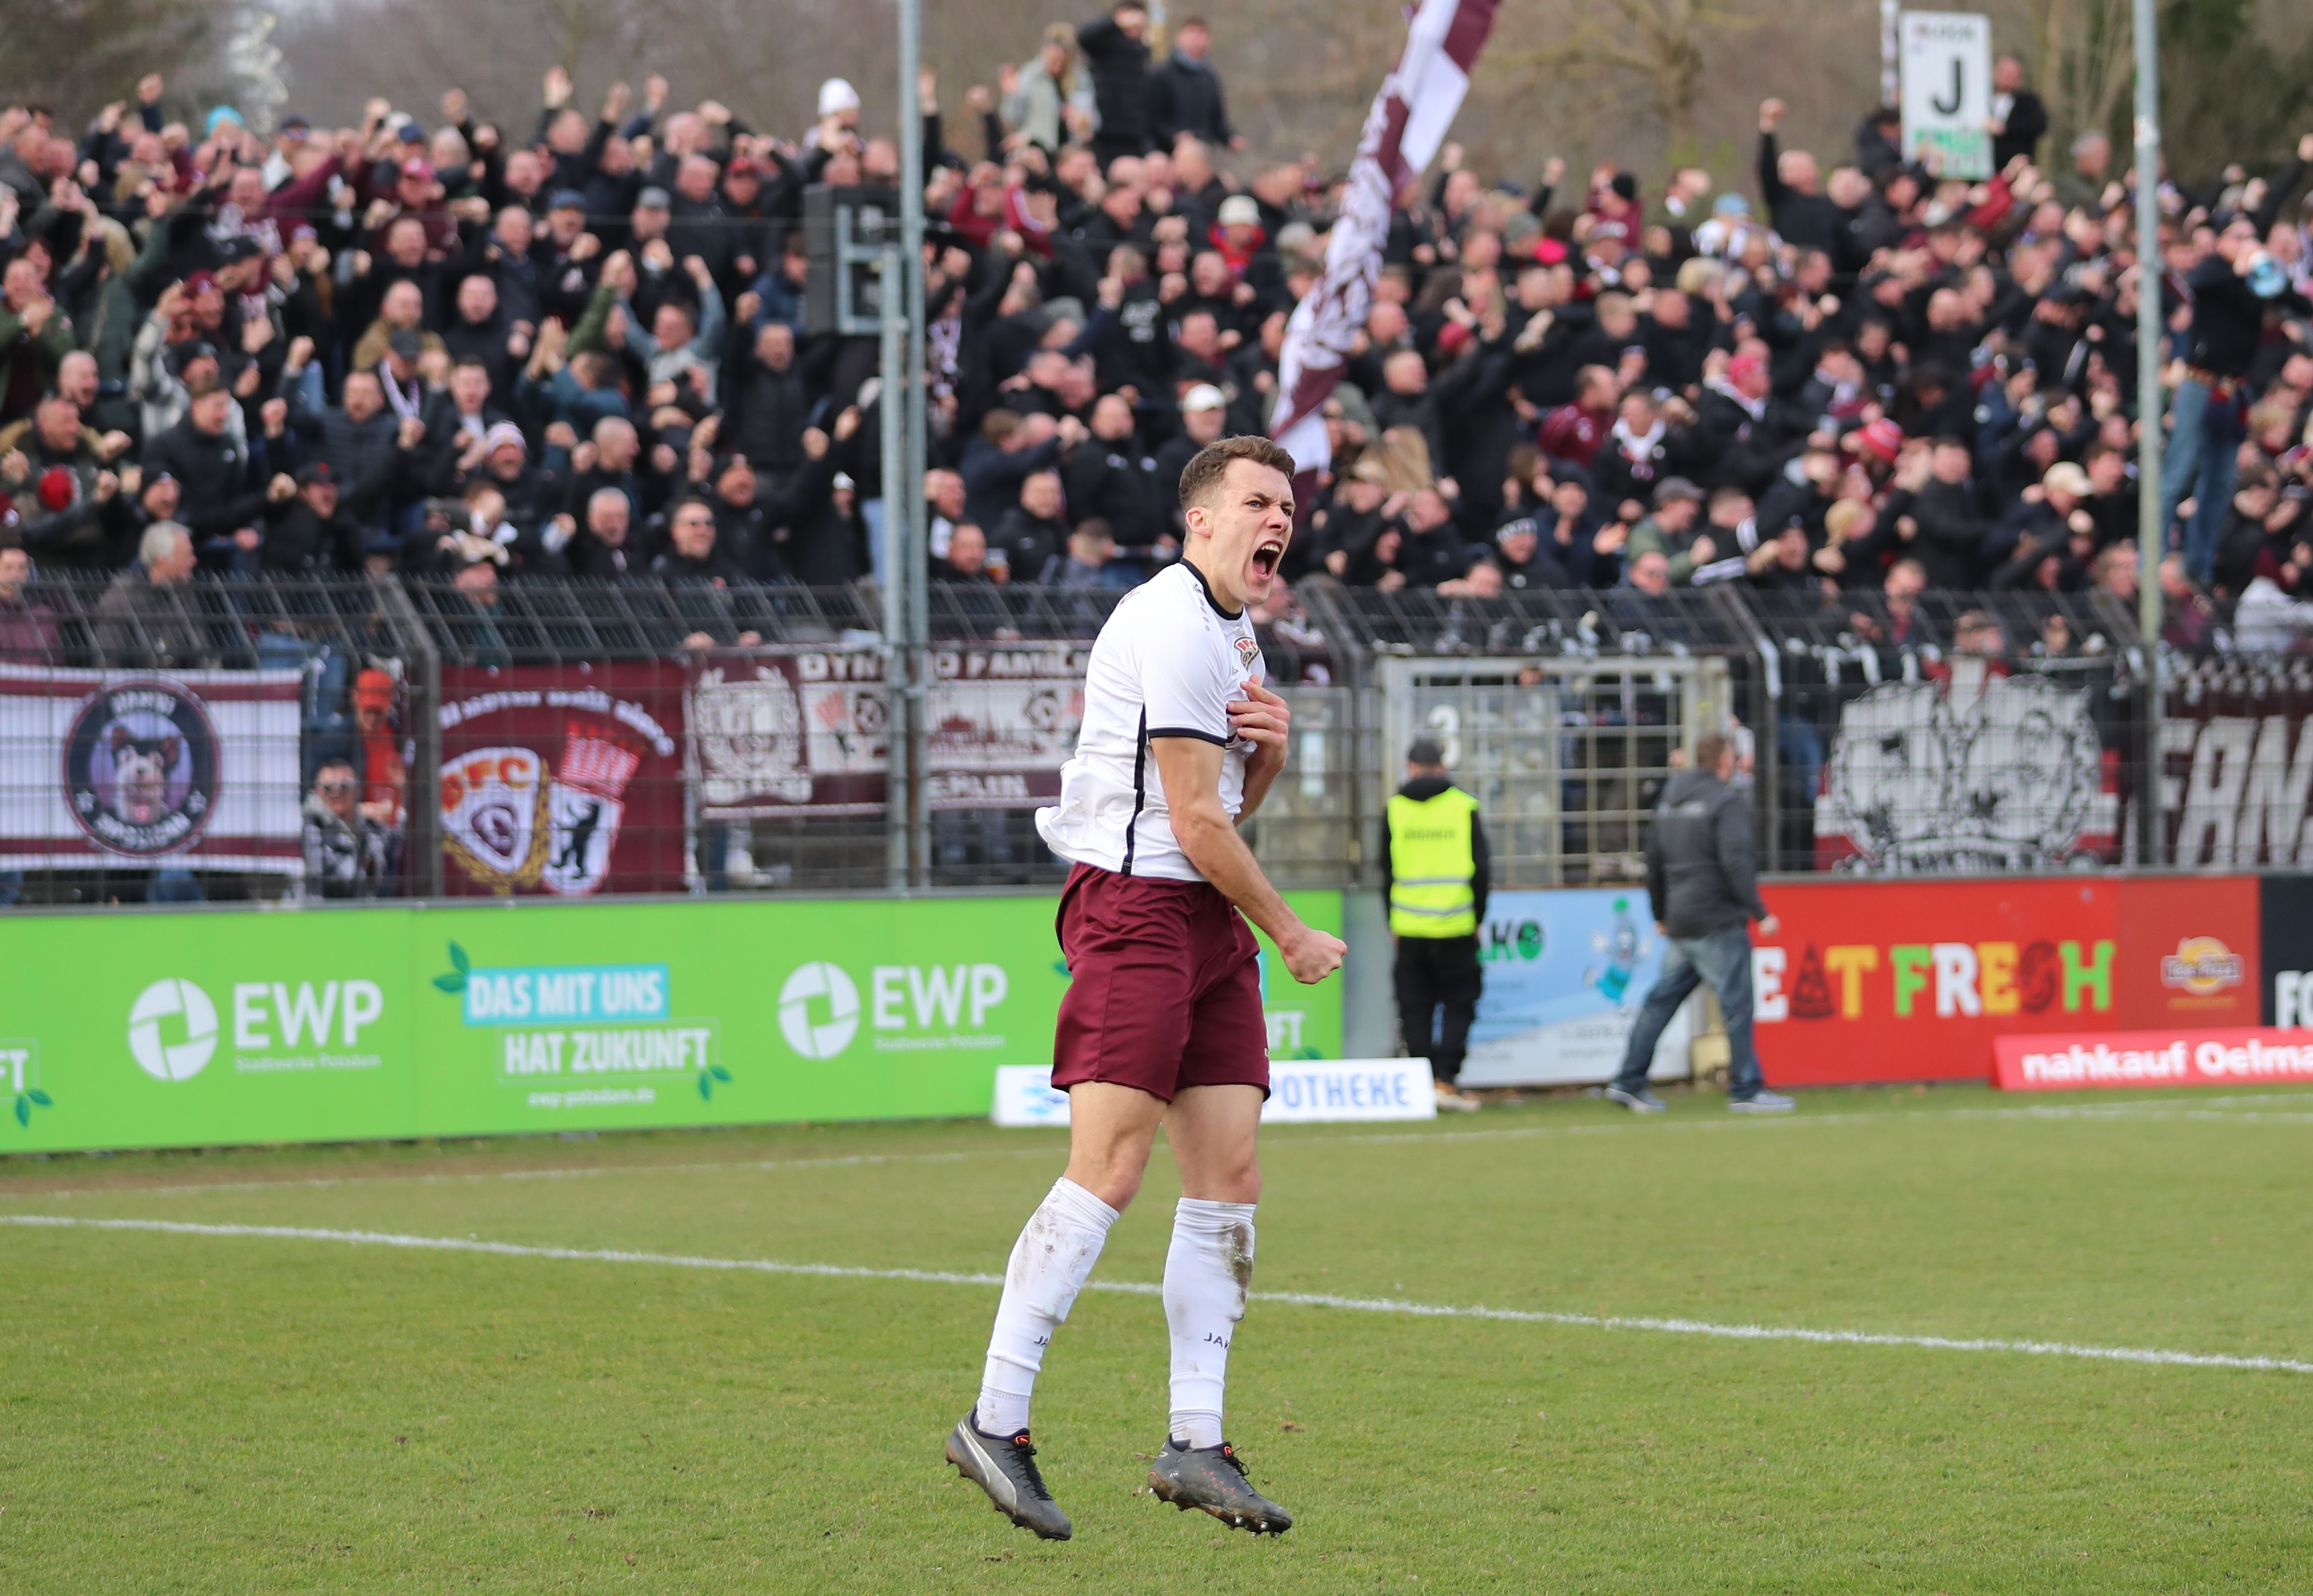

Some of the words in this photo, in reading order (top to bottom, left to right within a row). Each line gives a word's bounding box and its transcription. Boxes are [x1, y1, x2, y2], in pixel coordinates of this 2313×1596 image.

[1932, 55, 1961, 115] J
[2154, 715, 2313, 869] FAN
[234, 979, 384, 1049] EWP
[469, 974, 531, 1017] DAS
[537, 972, 596, 1015] MIT
[600, 969, 664, 1014] UNS
[872, 963, 1008, 1029] EWP
[504, 1032, 566, 1074] HAT
[571, 1027, 711, 1073] ZUKUNFT
[2022, 1040, 2187, 1082] nahkauf
